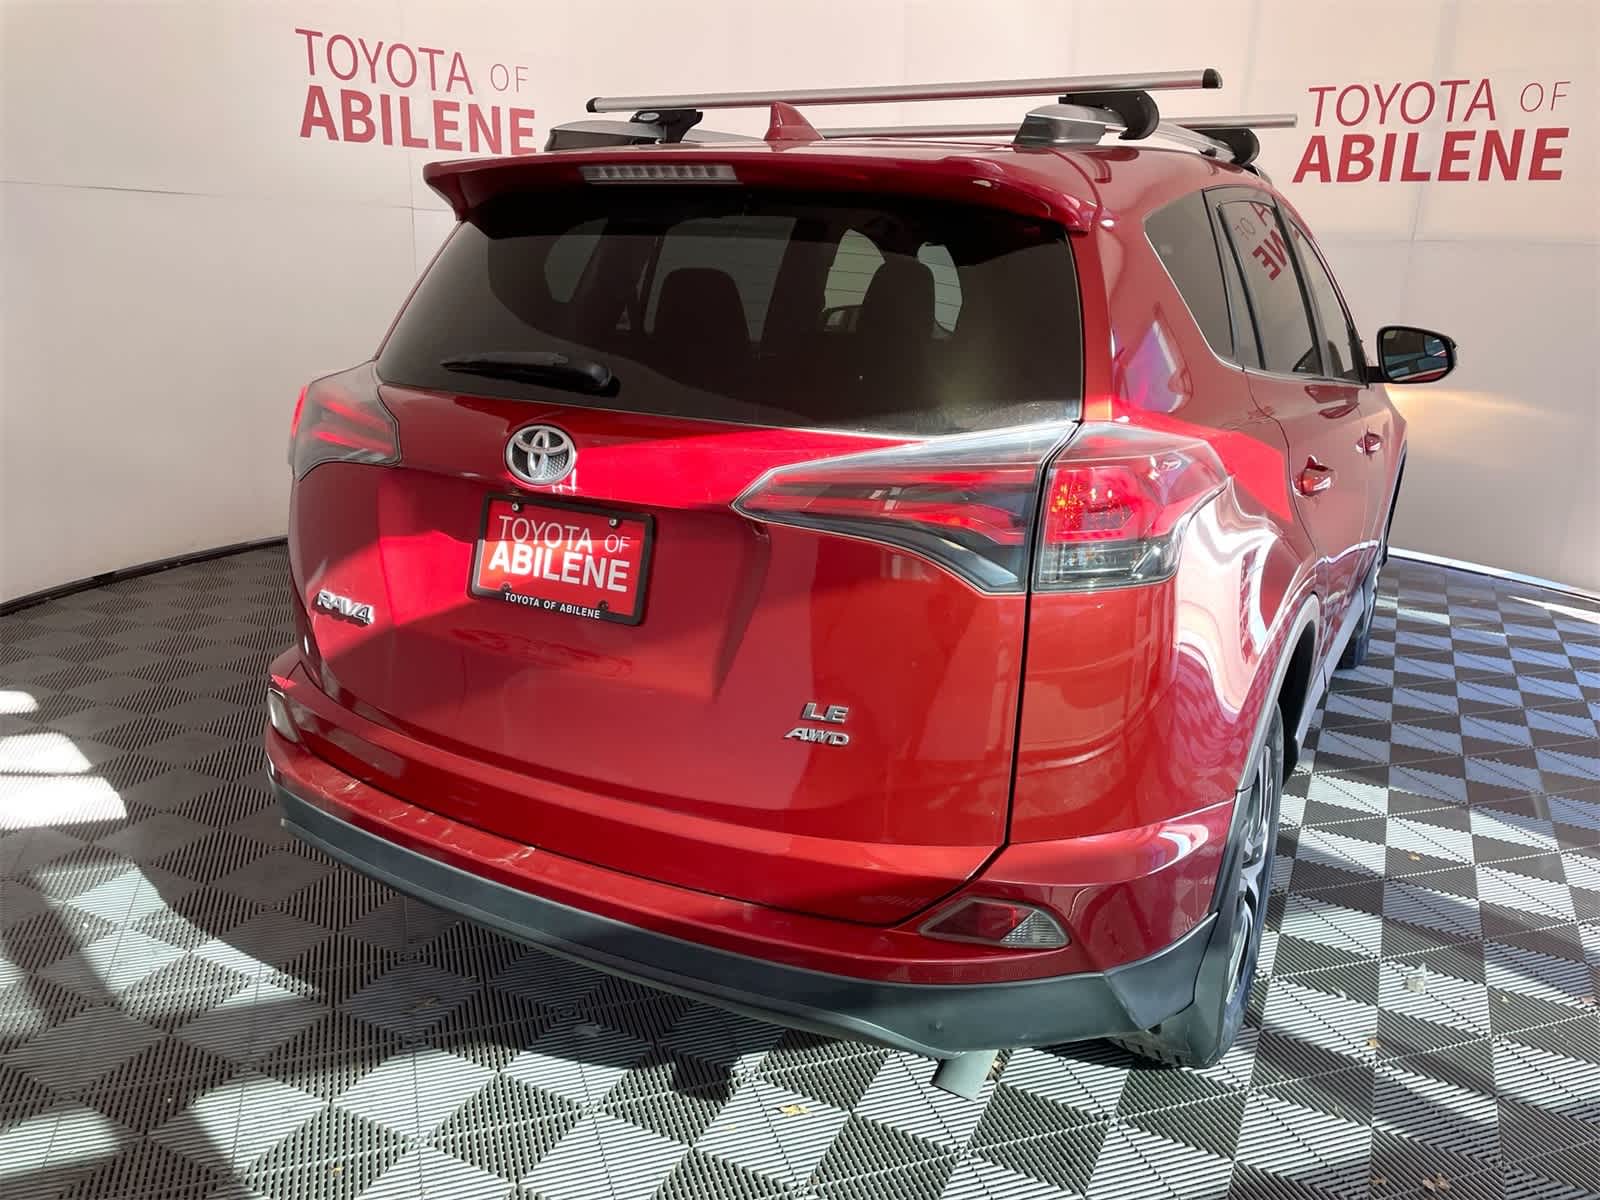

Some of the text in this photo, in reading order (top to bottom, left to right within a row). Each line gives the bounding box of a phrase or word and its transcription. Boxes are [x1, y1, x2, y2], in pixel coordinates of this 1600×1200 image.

[295, 28, 529, 95] TOYOTA OF
[299, 84, 537, 155] ABILENE
[1308, 78, 1571, 127] TOYOTA OF
[1292, 127, 1570, 183] ABILENE
[498, 515, 631, 553] TOYOTA OF
[488, 540, 630, 593] ABILENE
[317, 589, 375, 625] RAV4
[505, 592, 600, 619] TOYOTA OF ABILENE
[802, 702, 849, 724] LE
[784, 727, 849, 745] AWD
